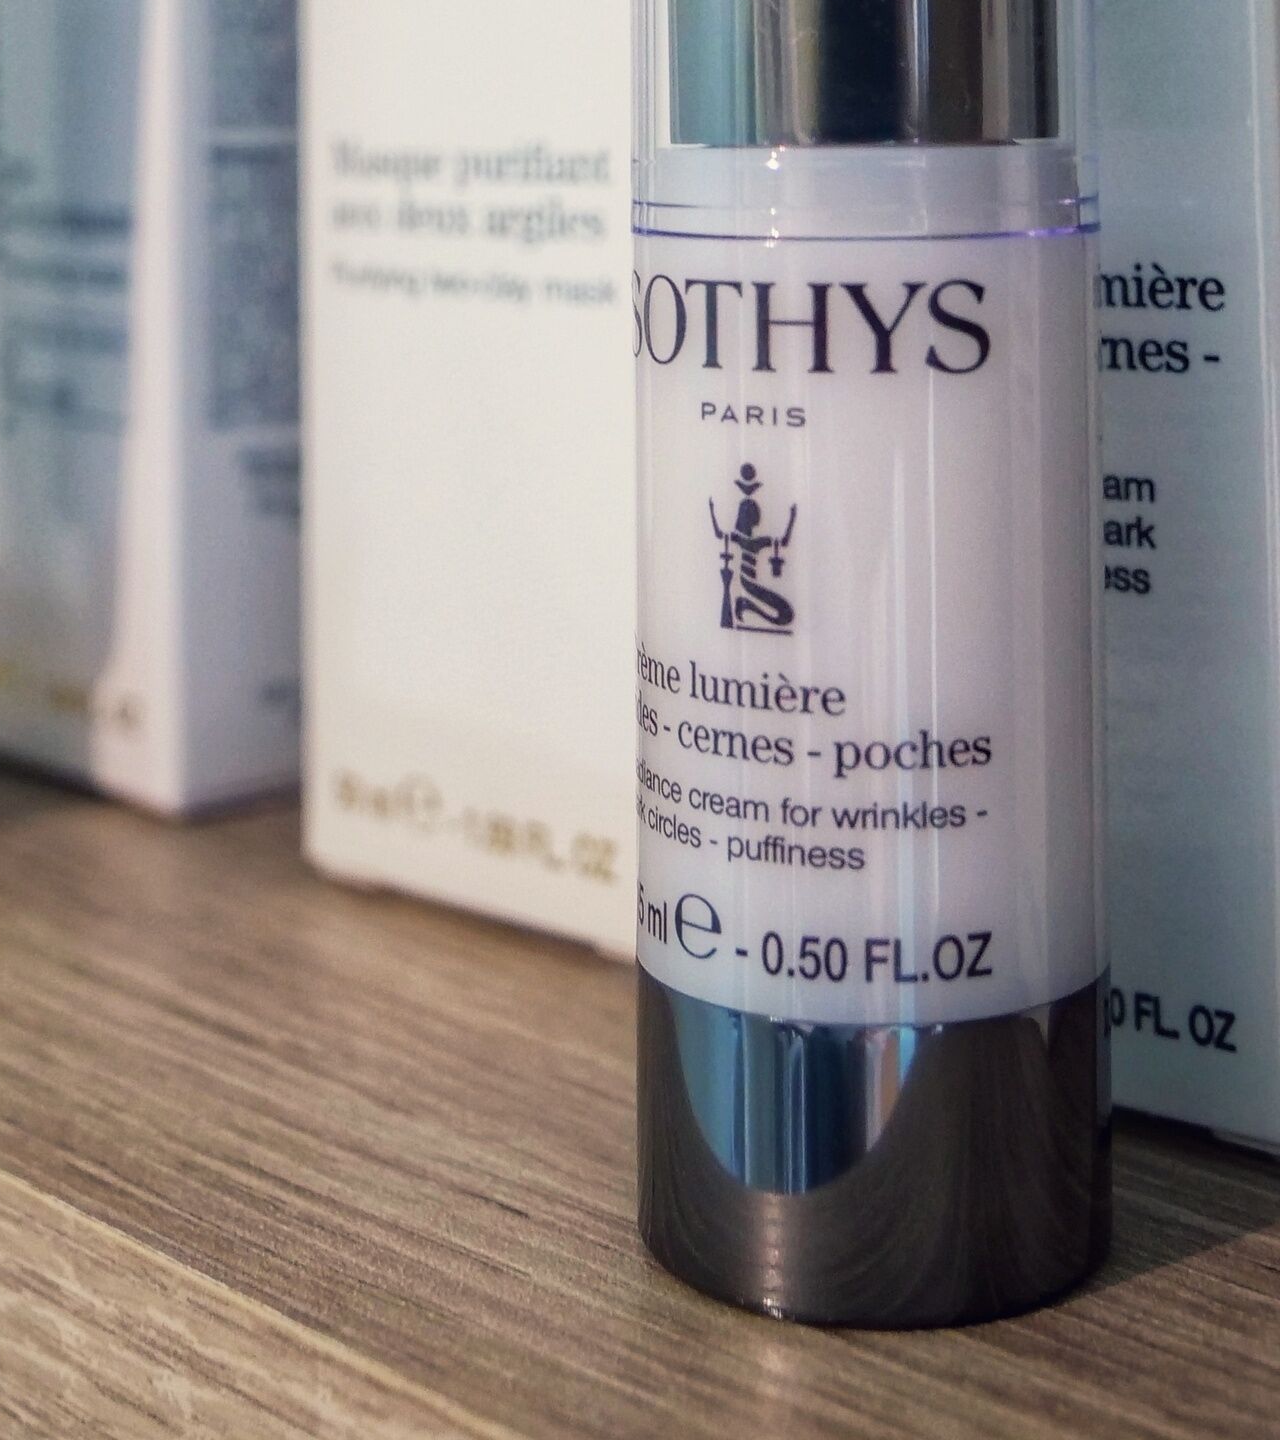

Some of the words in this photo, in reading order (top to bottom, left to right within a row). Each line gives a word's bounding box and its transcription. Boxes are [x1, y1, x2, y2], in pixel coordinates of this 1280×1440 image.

[1095, 262, 1225, 311] mière
[701, 401, 807, 427] PARIS
[689, 660, 846, 716] lumière
[678, 720, 795, 767] cernes
[833, 729, 993, 778] poches
[688, 786, 770, 823] cream
[781, 797, 821, 830] for
[832, 803, 967, 830] wrinkles
[647, 806, 702, 850] circles
[727, 834, 865, 871] puffiness
[647, 900, 668, 944] ml
[761, 931, 848, 981] 0.50
[865, 931, 993, 983] FL.OZ
[1189, 1004, 1236, 1053] OZ
